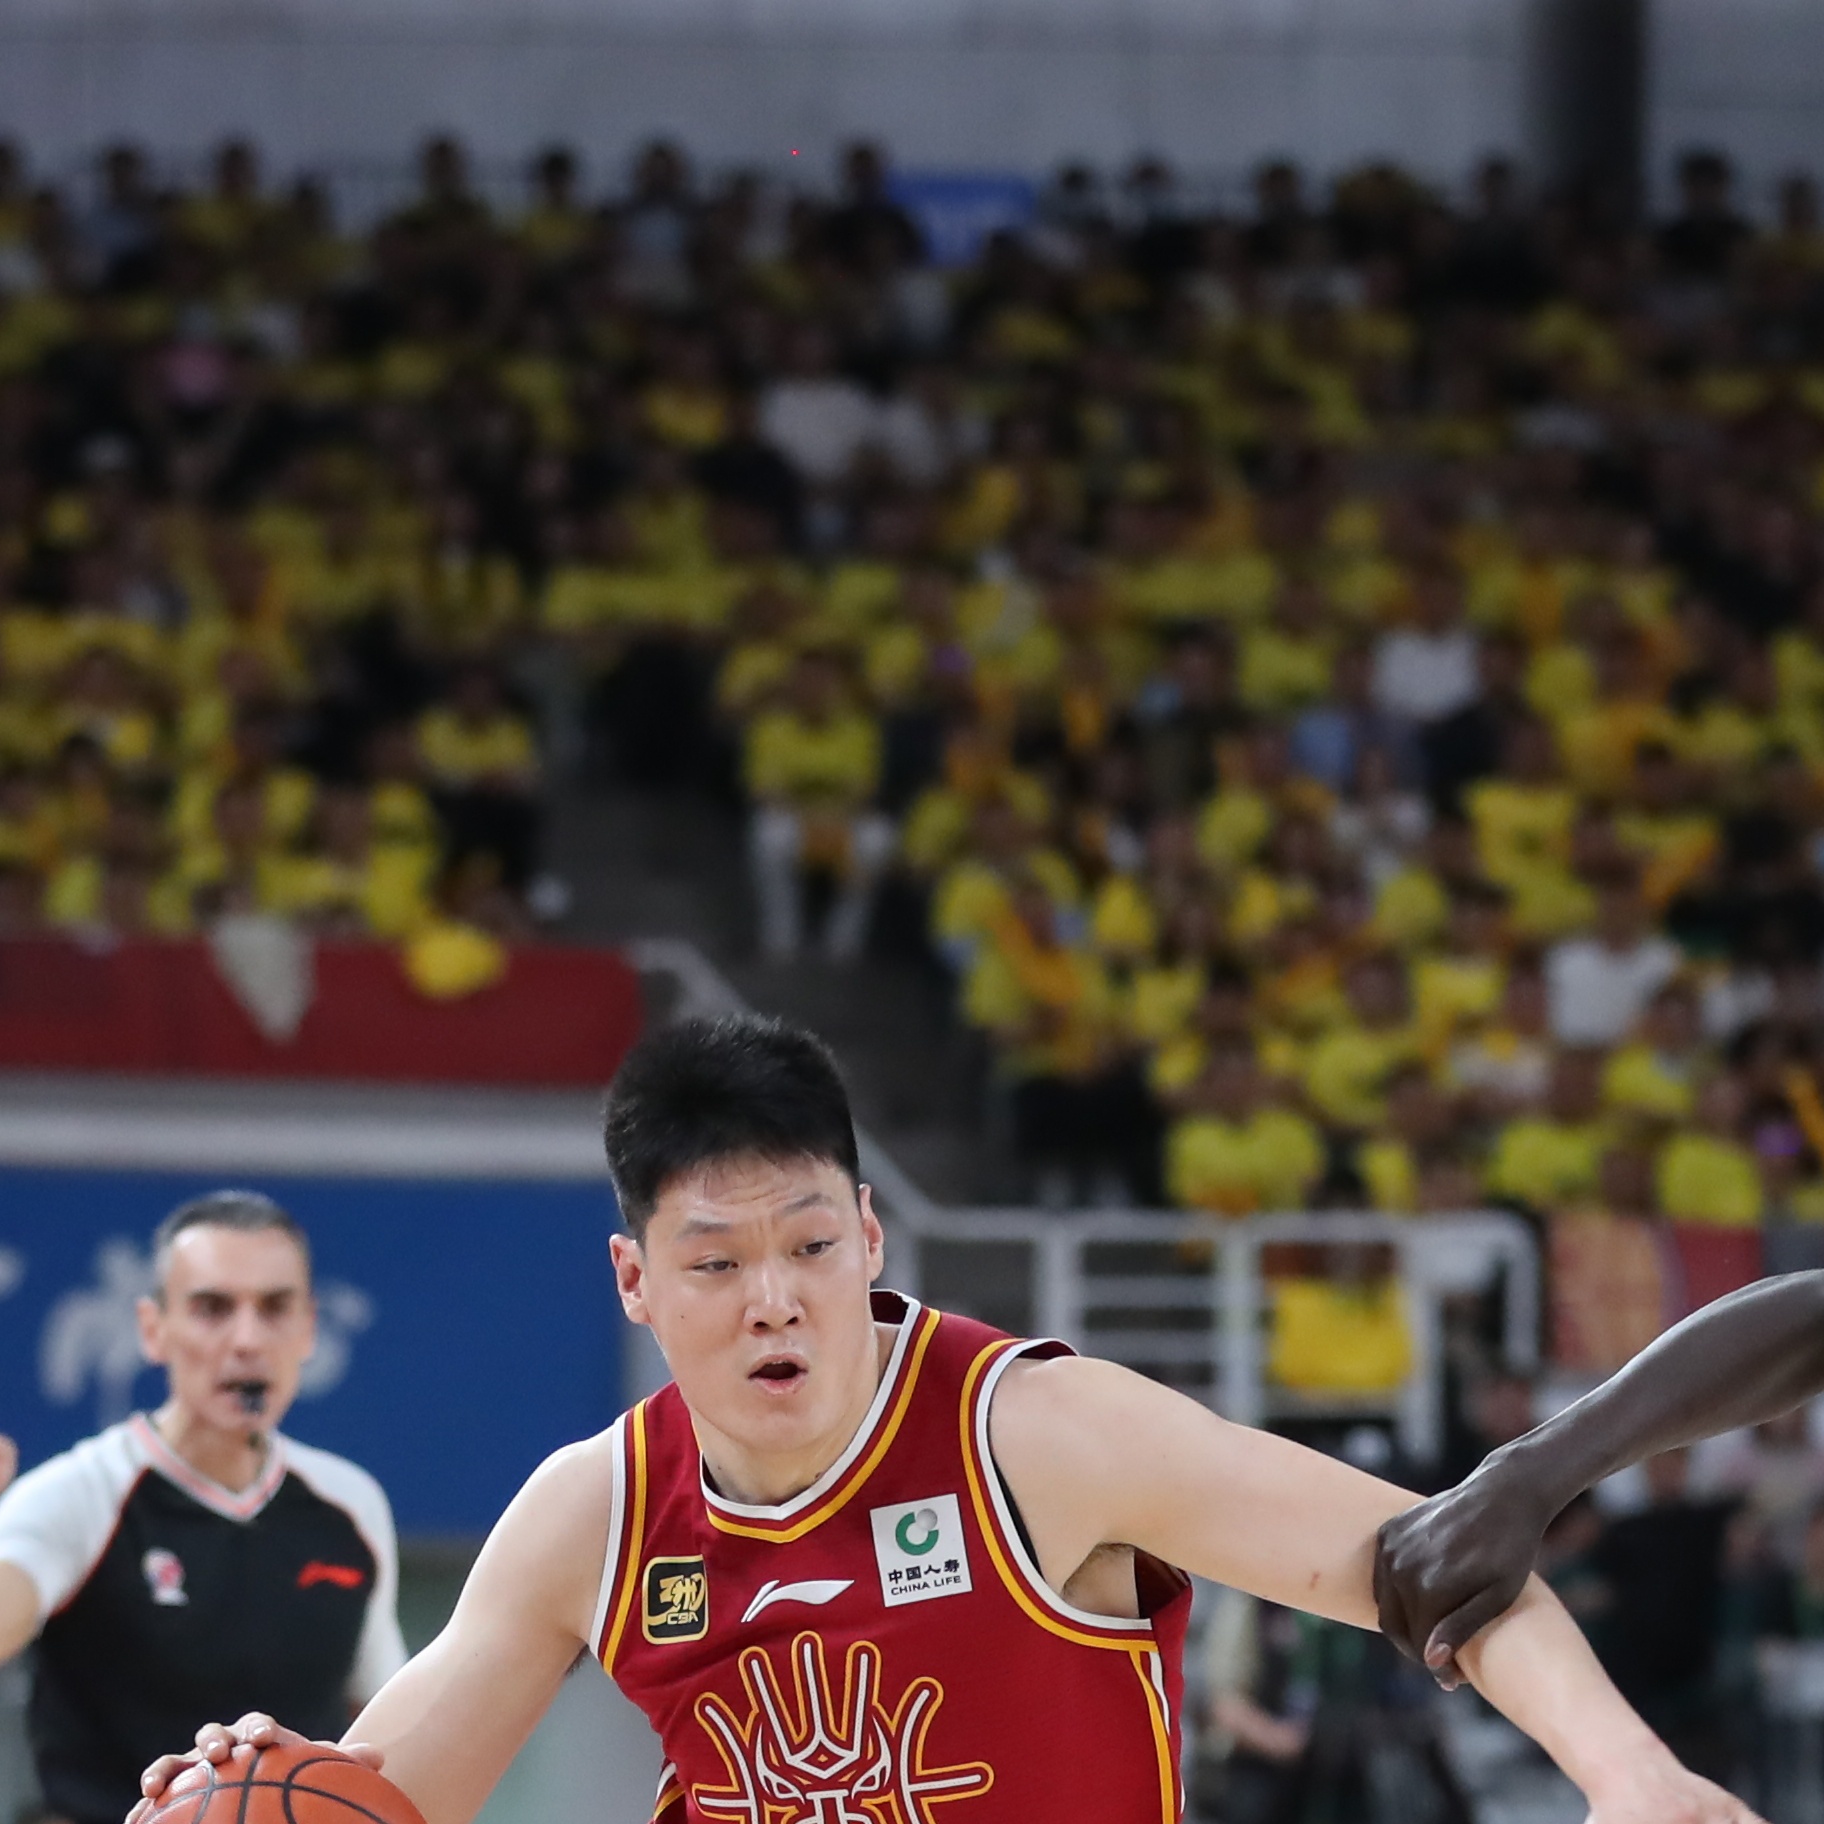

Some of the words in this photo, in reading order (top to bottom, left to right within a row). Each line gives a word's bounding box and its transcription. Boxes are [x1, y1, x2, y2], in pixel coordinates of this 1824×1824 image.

[887, 1559, 960, 1584] 中国人寿
[890, 1581, 931, 1596] CHINA
[933, 1575, 962, 1588] LIFE
[666, 1612, 699, 1625] CBA
